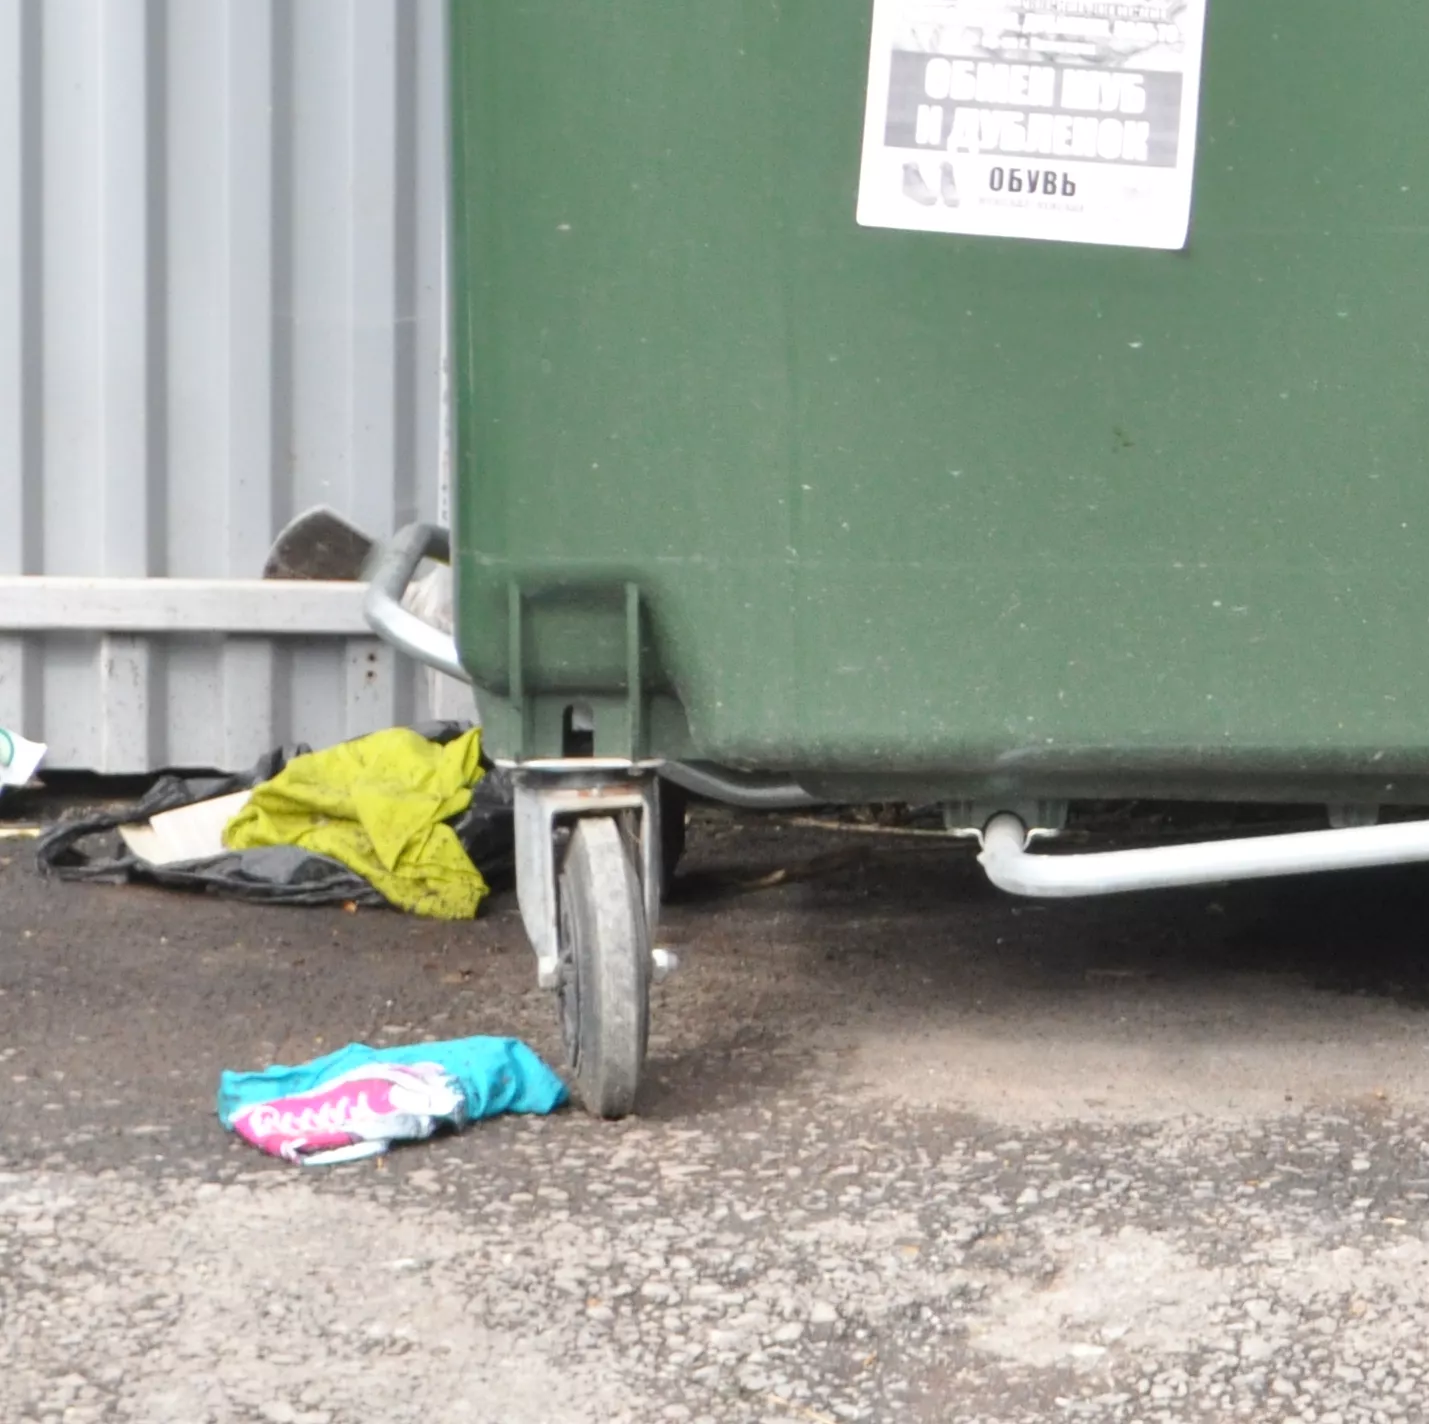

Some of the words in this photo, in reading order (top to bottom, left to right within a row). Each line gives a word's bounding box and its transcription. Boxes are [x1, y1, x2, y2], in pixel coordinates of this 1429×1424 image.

[924, 58, 1055, 107] ОБМЕН
[1060, 69, 1146, 114] ШУБ
[915, 105, 944, 145] И
[947, 106, 1150, 162] ДУБЛЕНОК
[989, 166, 1077, 197] ОБУВЬ
